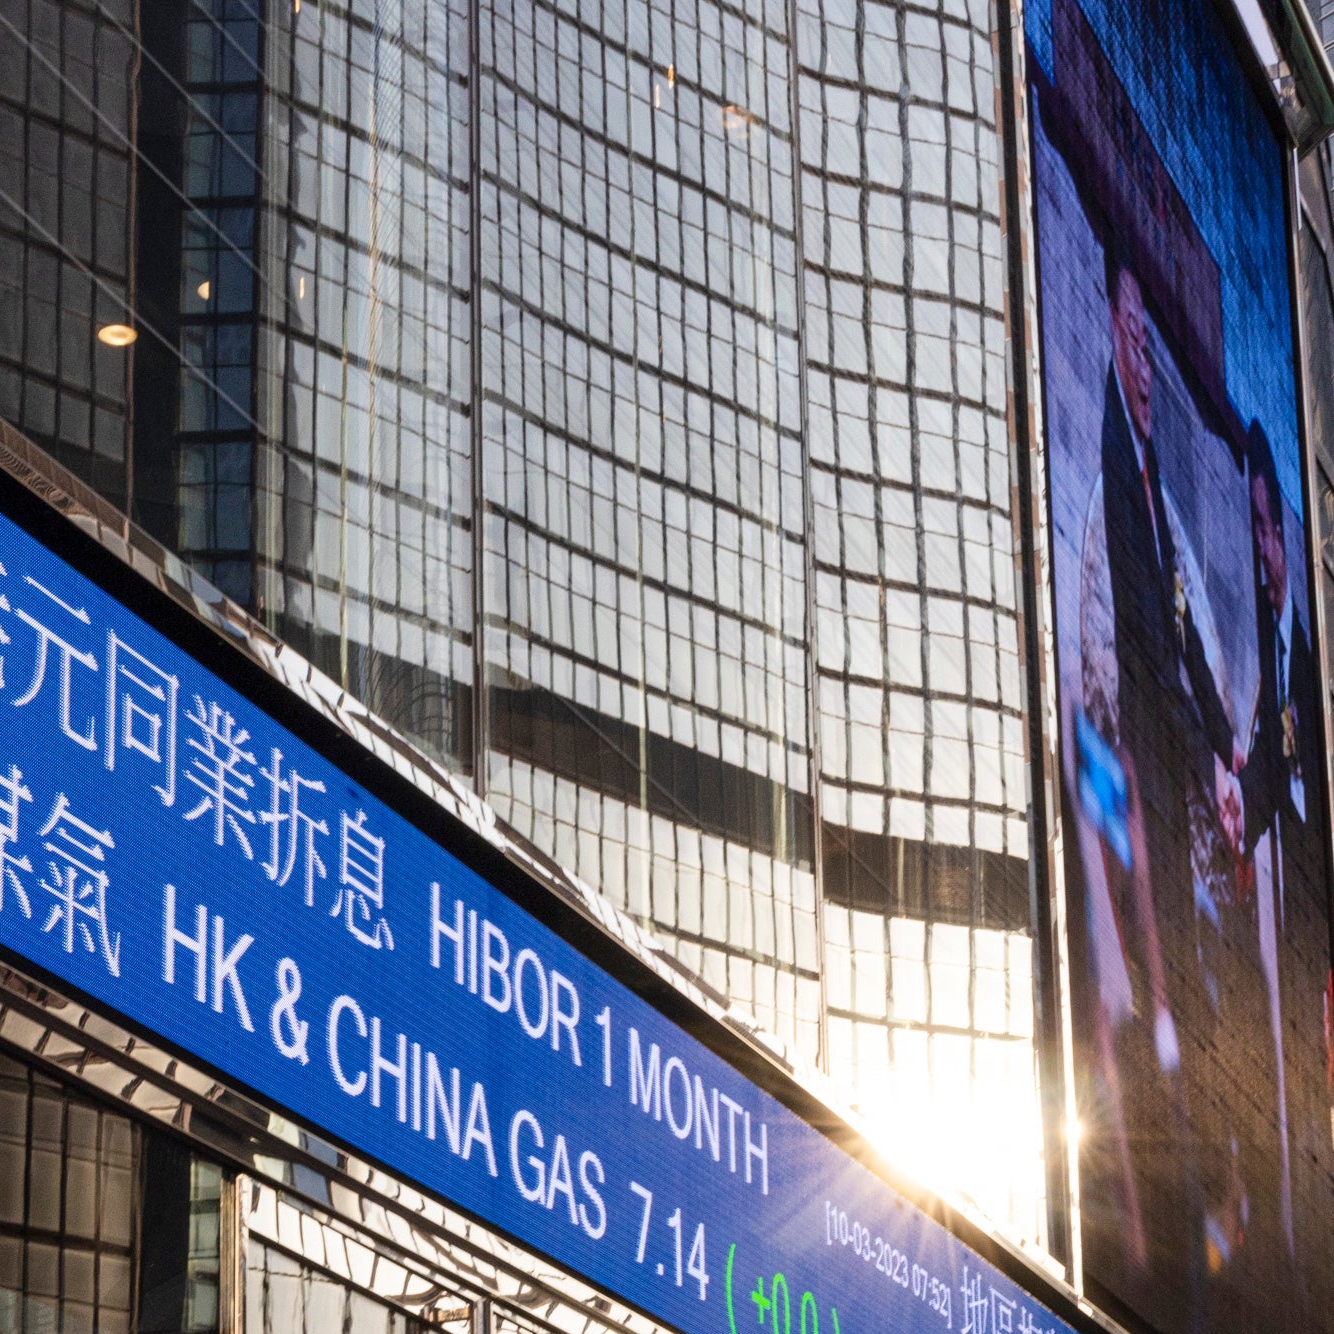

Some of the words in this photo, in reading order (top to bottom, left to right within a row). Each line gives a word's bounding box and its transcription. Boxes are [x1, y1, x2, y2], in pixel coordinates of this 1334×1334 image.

[162, 883, 255, 1032] HK
[269, 957, 310, 1066] &
[326, 993, 499, 1178] CHINA
[508, 1108, 607, 1240] GAS
[629, 1180, 711, 1302] 7.14
[430, 882, 583, 1067] HIBOR
[595, 1006, 613, 1087] 1
[629, 1027, 769, 1196] MONTH
